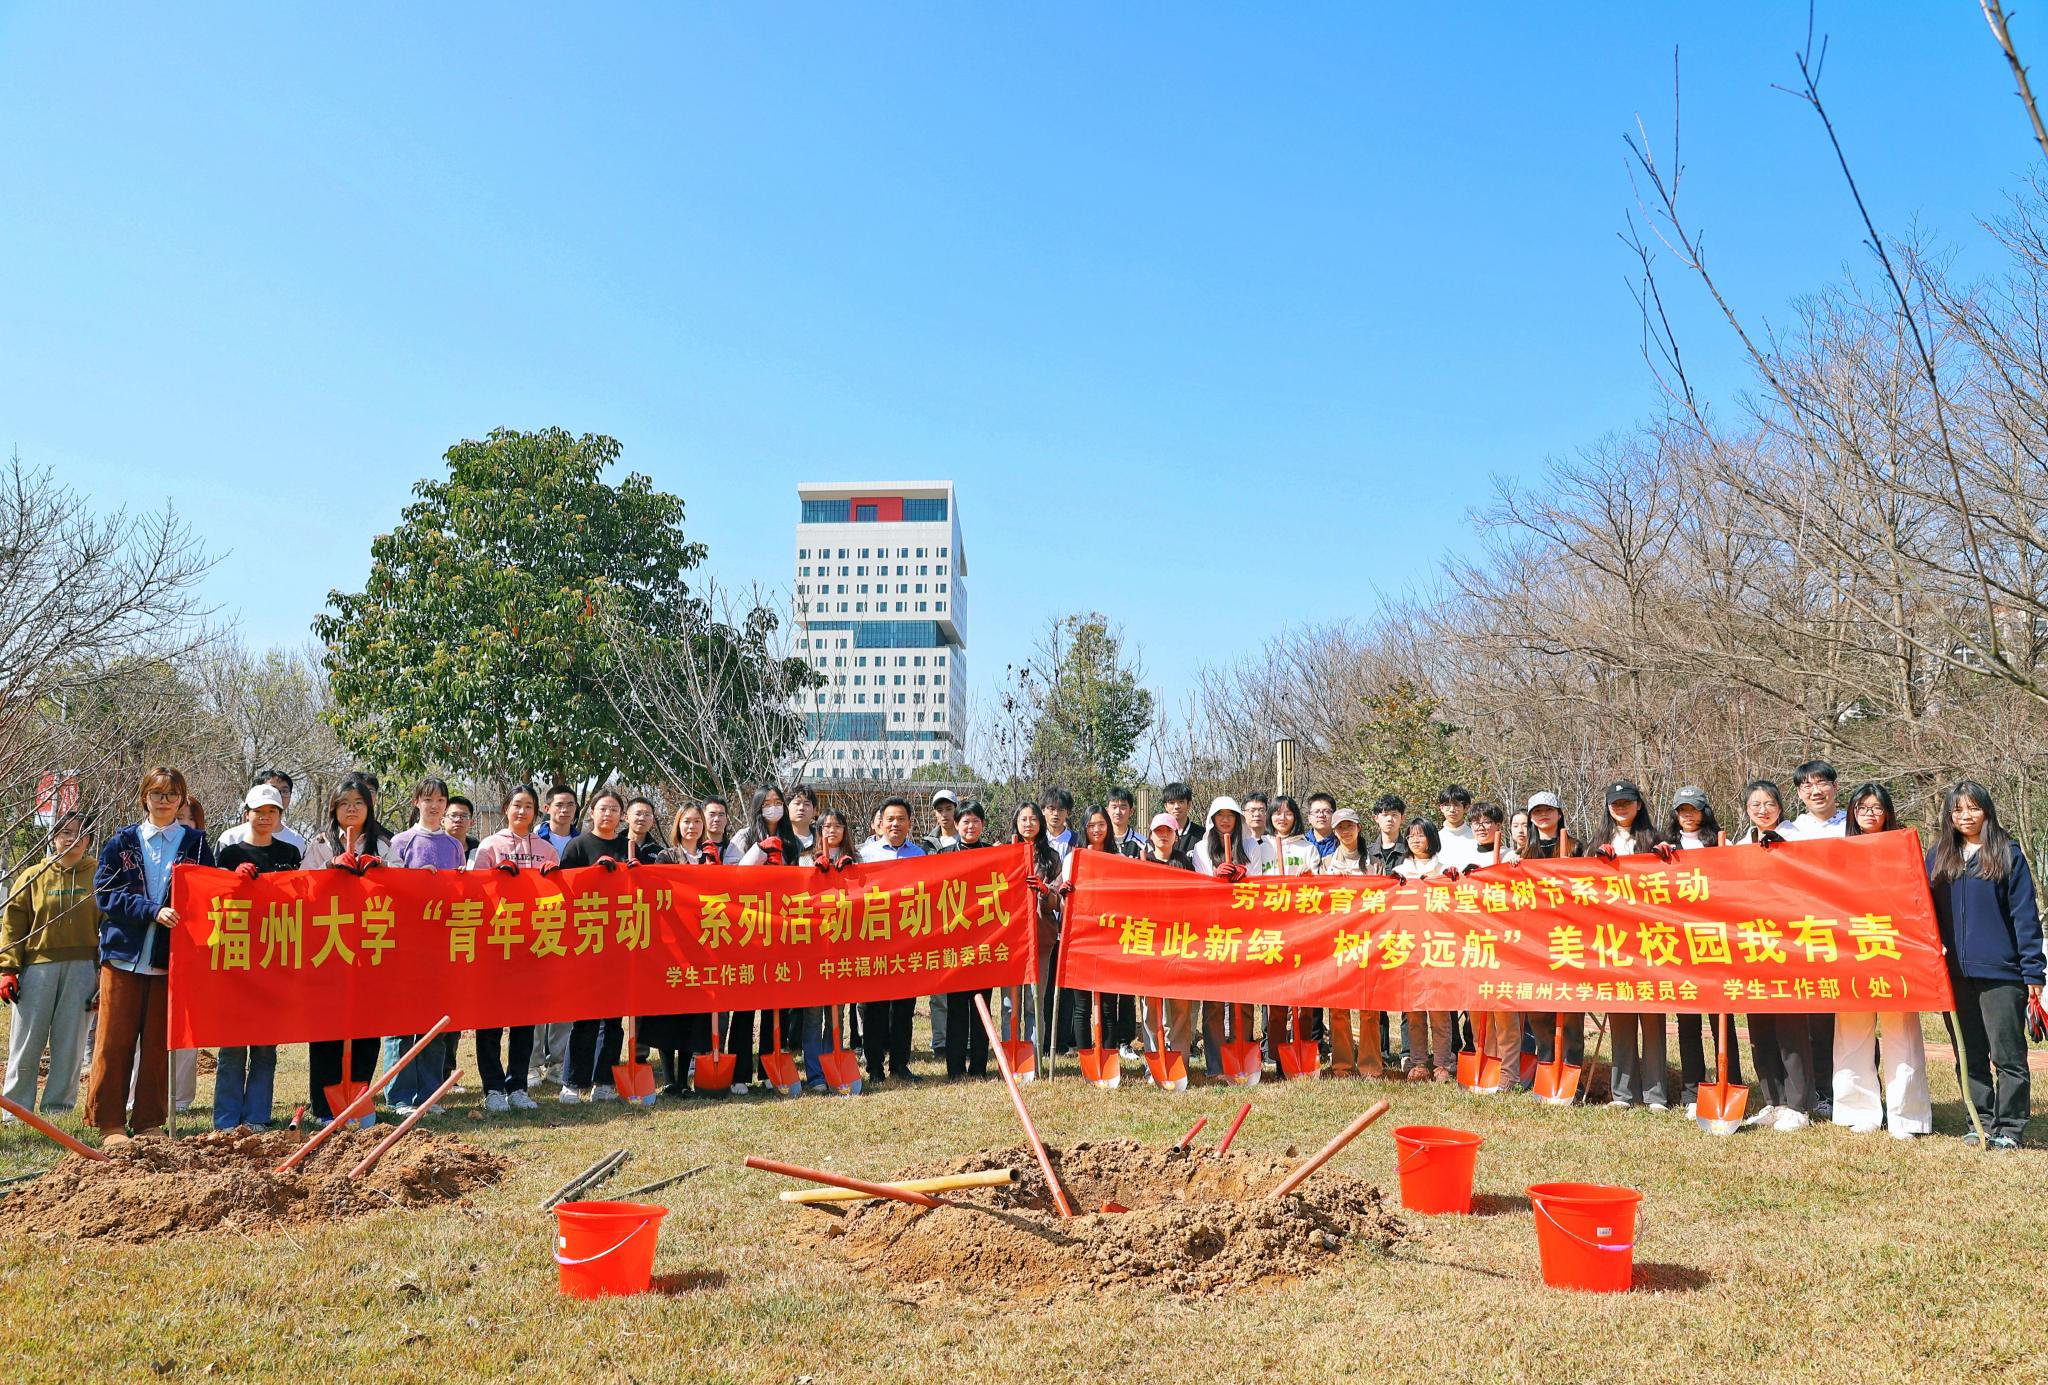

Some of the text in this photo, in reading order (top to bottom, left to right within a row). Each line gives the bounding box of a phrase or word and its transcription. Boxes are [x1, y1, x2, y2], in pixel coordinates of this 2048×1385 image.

[1231, 867, 1710, 915] 劳动教育第二课堂植树节系列活动
[207, 872, 1011, 971] 福州大学 “青年爱劳动” 系列活动启动仪式
[1548, 913, 1903, 971] 美化校园我有责
[666, 942, 1009, 988] 学生工作部（处） 中共福州大学后勤委员会
[1478, 975, 1908, 1002] 中共福州大学后勤委员会 学生工作部（处）
